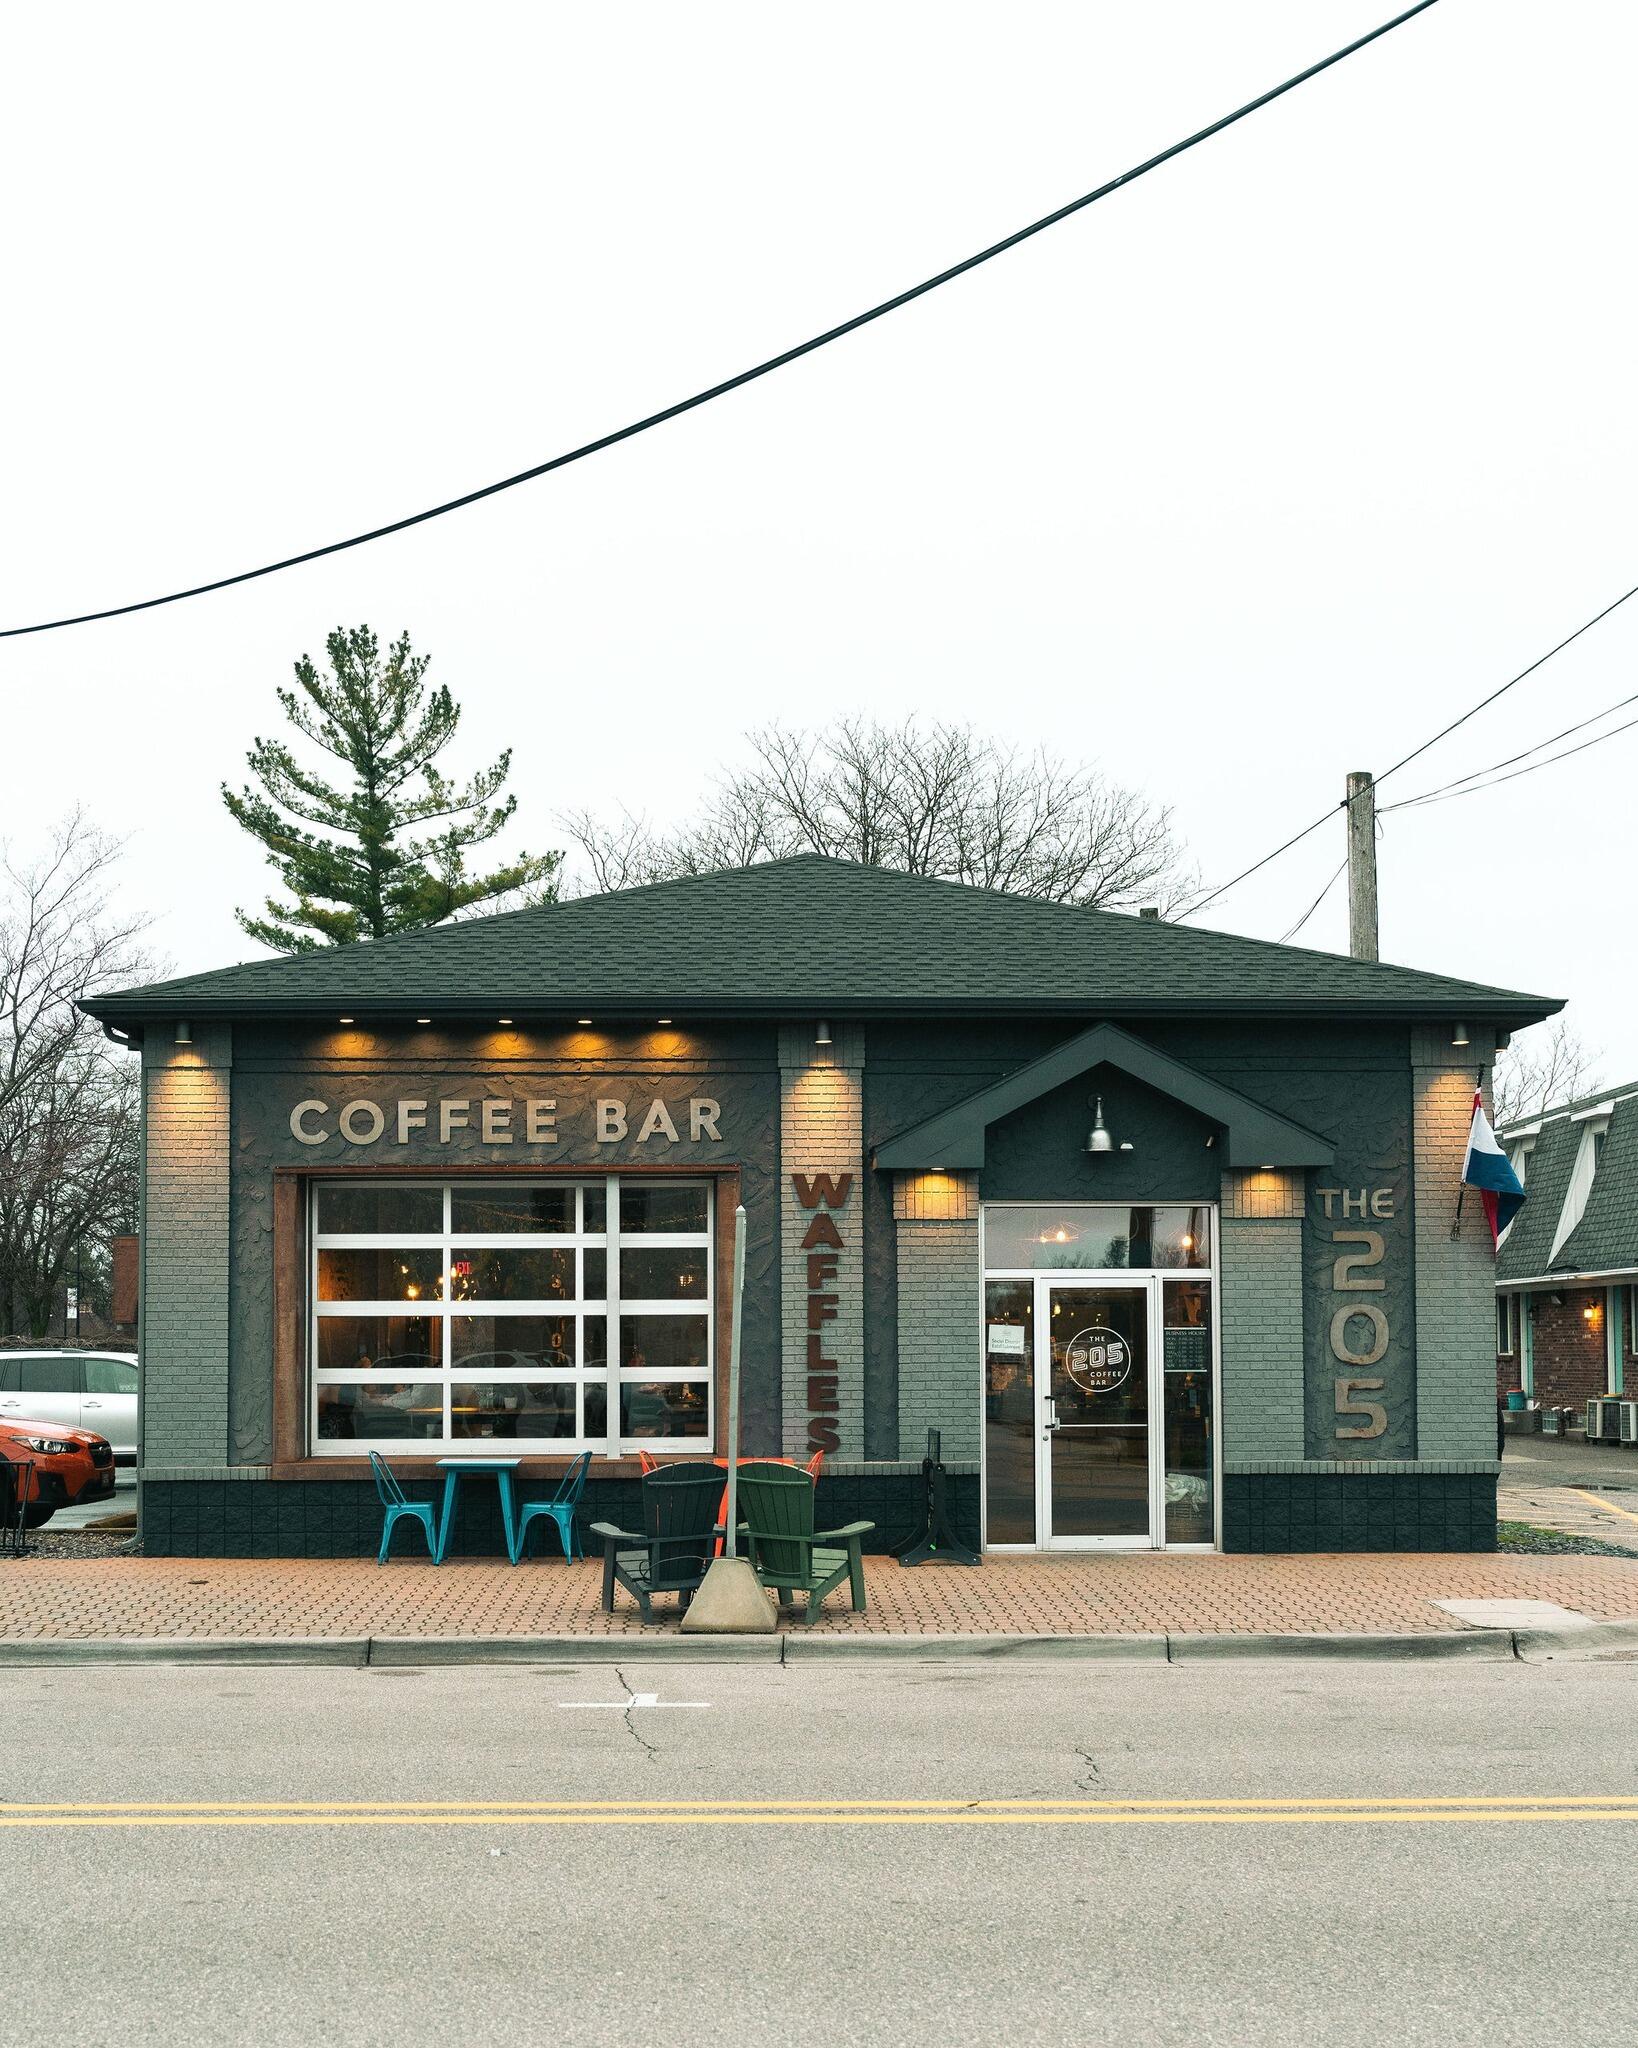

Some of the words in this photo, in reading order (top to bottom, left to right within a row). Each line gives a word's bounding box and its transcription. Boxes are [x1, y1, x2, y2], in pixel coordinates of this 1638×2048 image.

[289, 1099, 558, 1145] COFFEE
[596, 1098, 722, 1143] BAR
[1316, 1188, 1395, 1218] THE
[792, 1173, 853, 1454] WAFFLES
[1330, 1230, 1390, 1439] 205
[1072, 1342, 1124, 1372] 205
